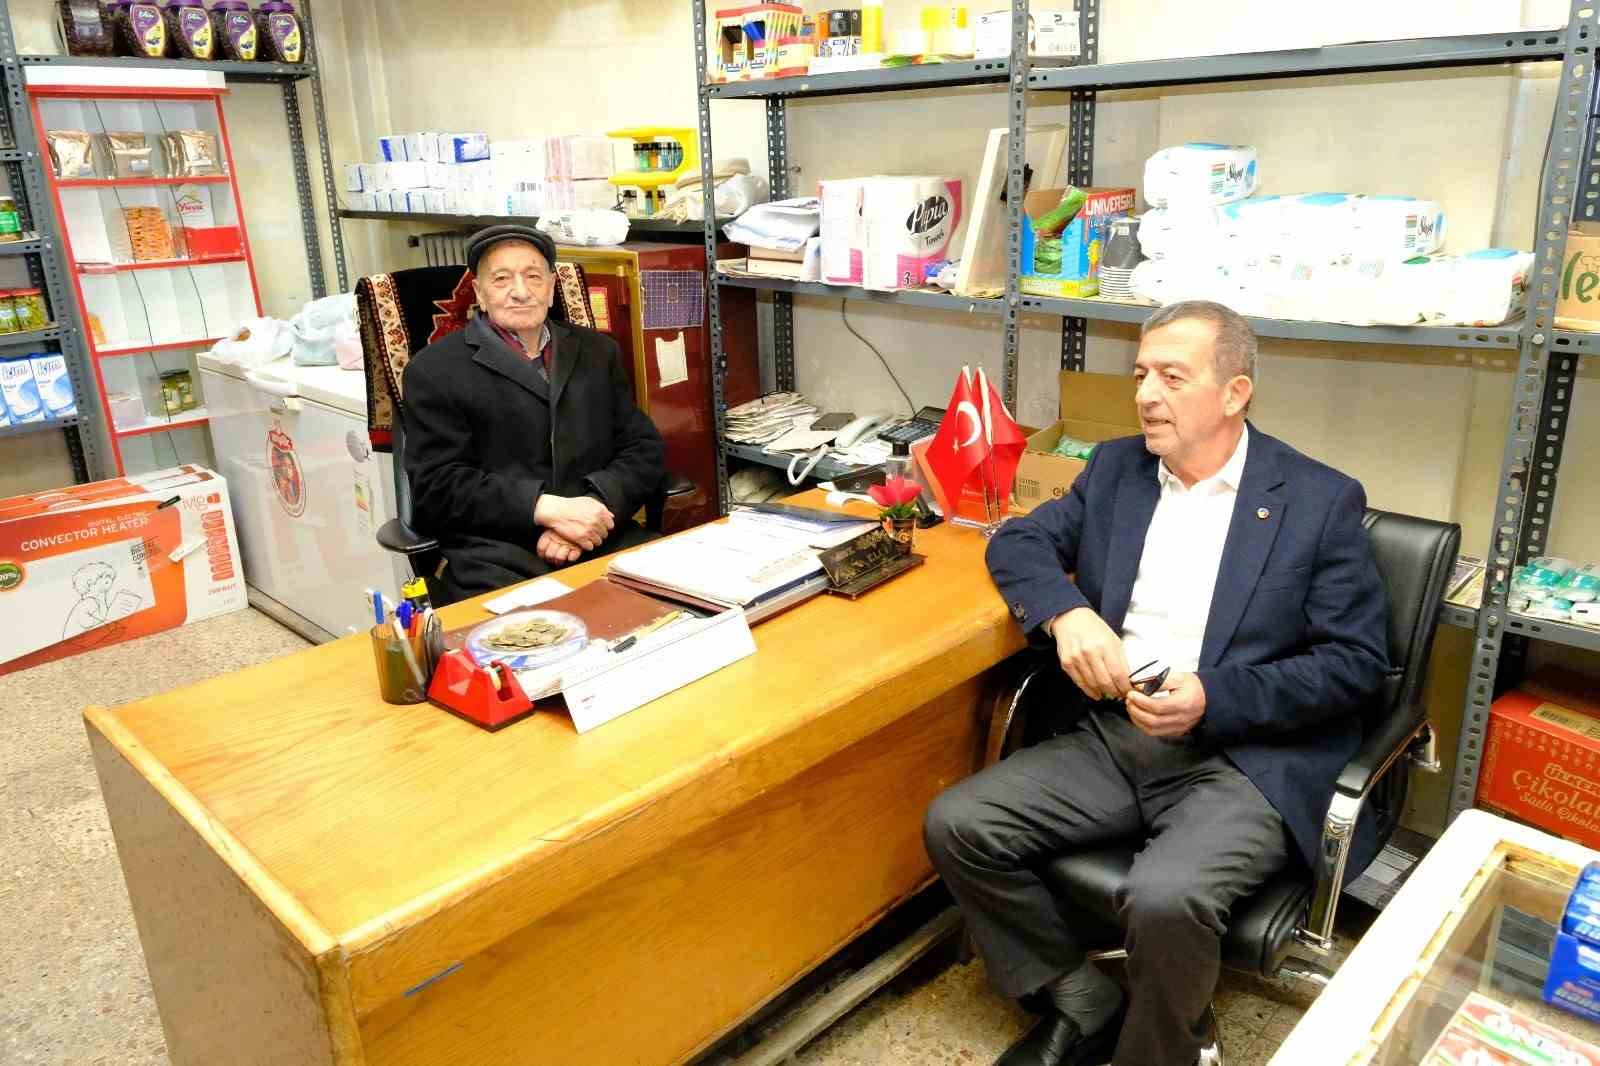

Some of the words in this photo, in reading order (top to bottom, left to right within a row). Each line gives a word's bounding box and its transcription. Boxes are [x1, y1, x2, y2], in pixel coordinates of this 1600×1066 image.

[1085, 191, 1135, 216] UNIVERSAL
[20, 526, 98, 552] CONVECTOR
[101, 516, 149, 535] HEATER
